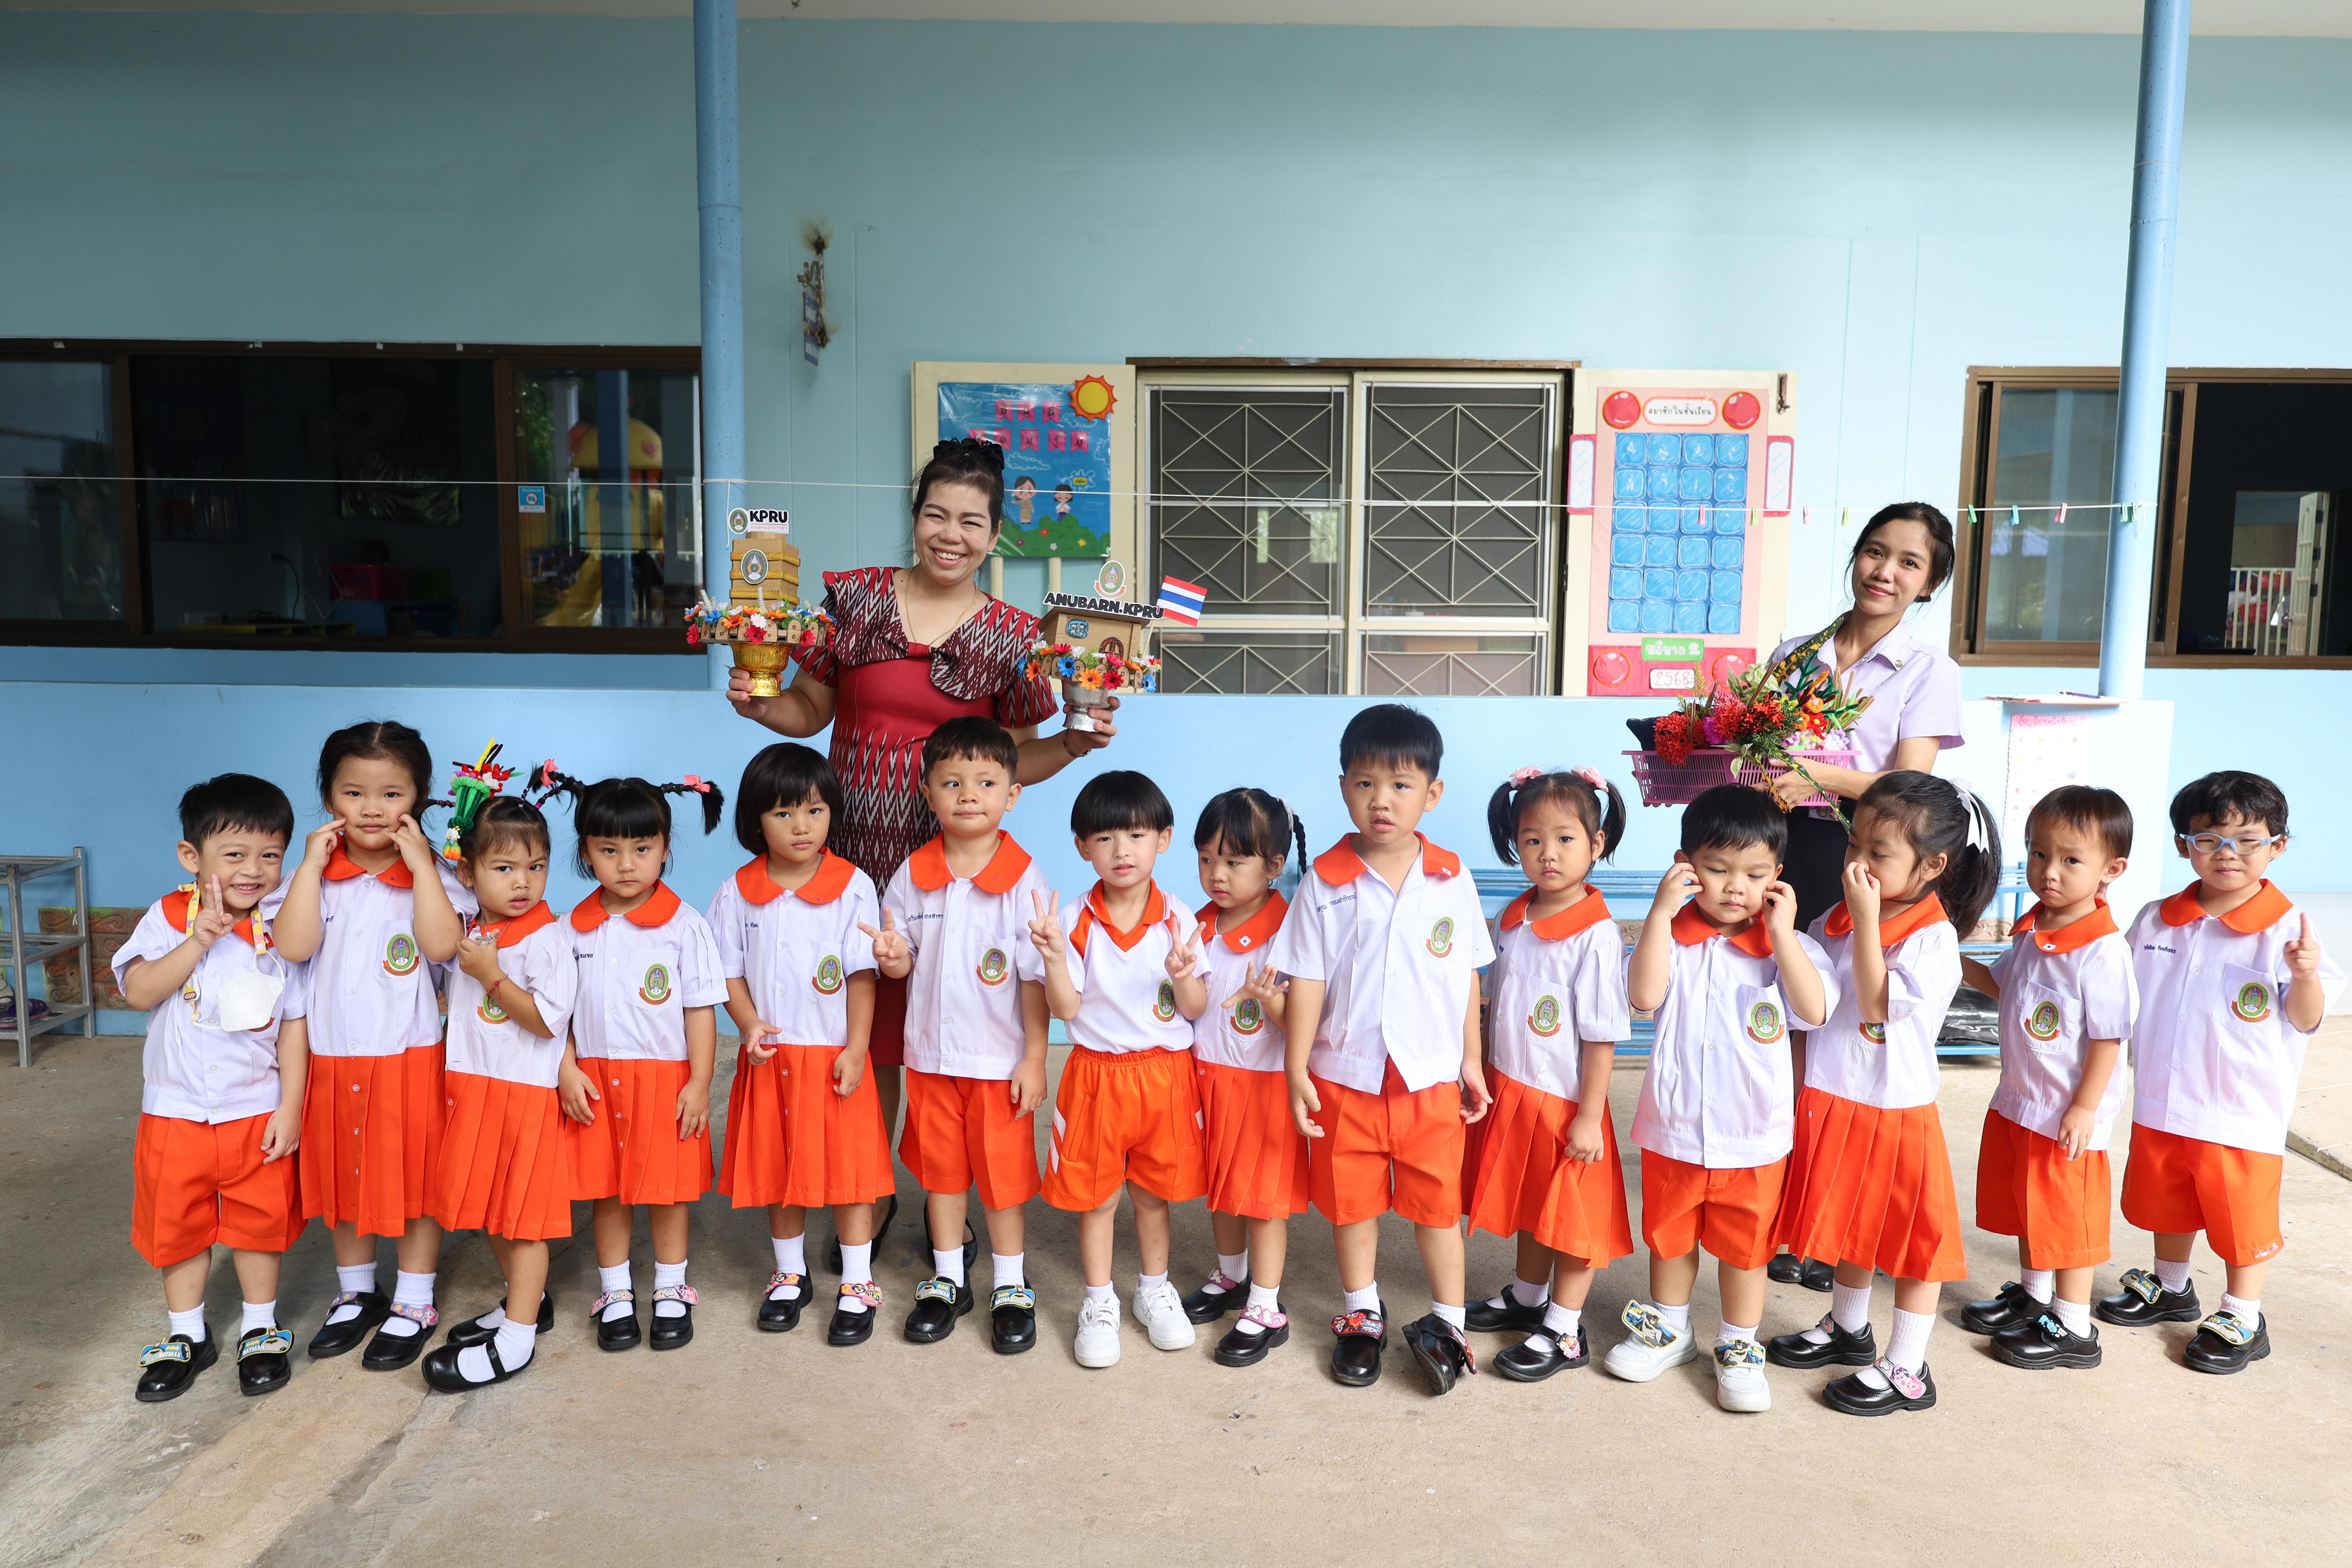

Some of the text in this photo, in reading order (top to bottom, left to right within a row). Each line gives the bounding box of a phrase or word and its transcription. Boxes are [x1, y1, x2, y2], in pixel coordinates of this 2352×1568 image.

[1648, 403, 1712, 415] สมาชิกในชั้นเรียน
[750, 510, 788, 523] KPRU
[1044, 592, 1164, 619] ANUBARN.KPRU
[1689, 642, 1701, 655] 2
[1655, 671, 1690, 686] 2568
[931, 1288, 950, 1298] BATMAN
[995, 1296, 1014, 1305] BATMAN
[242, 1344, 265, 1355] BATMAN
